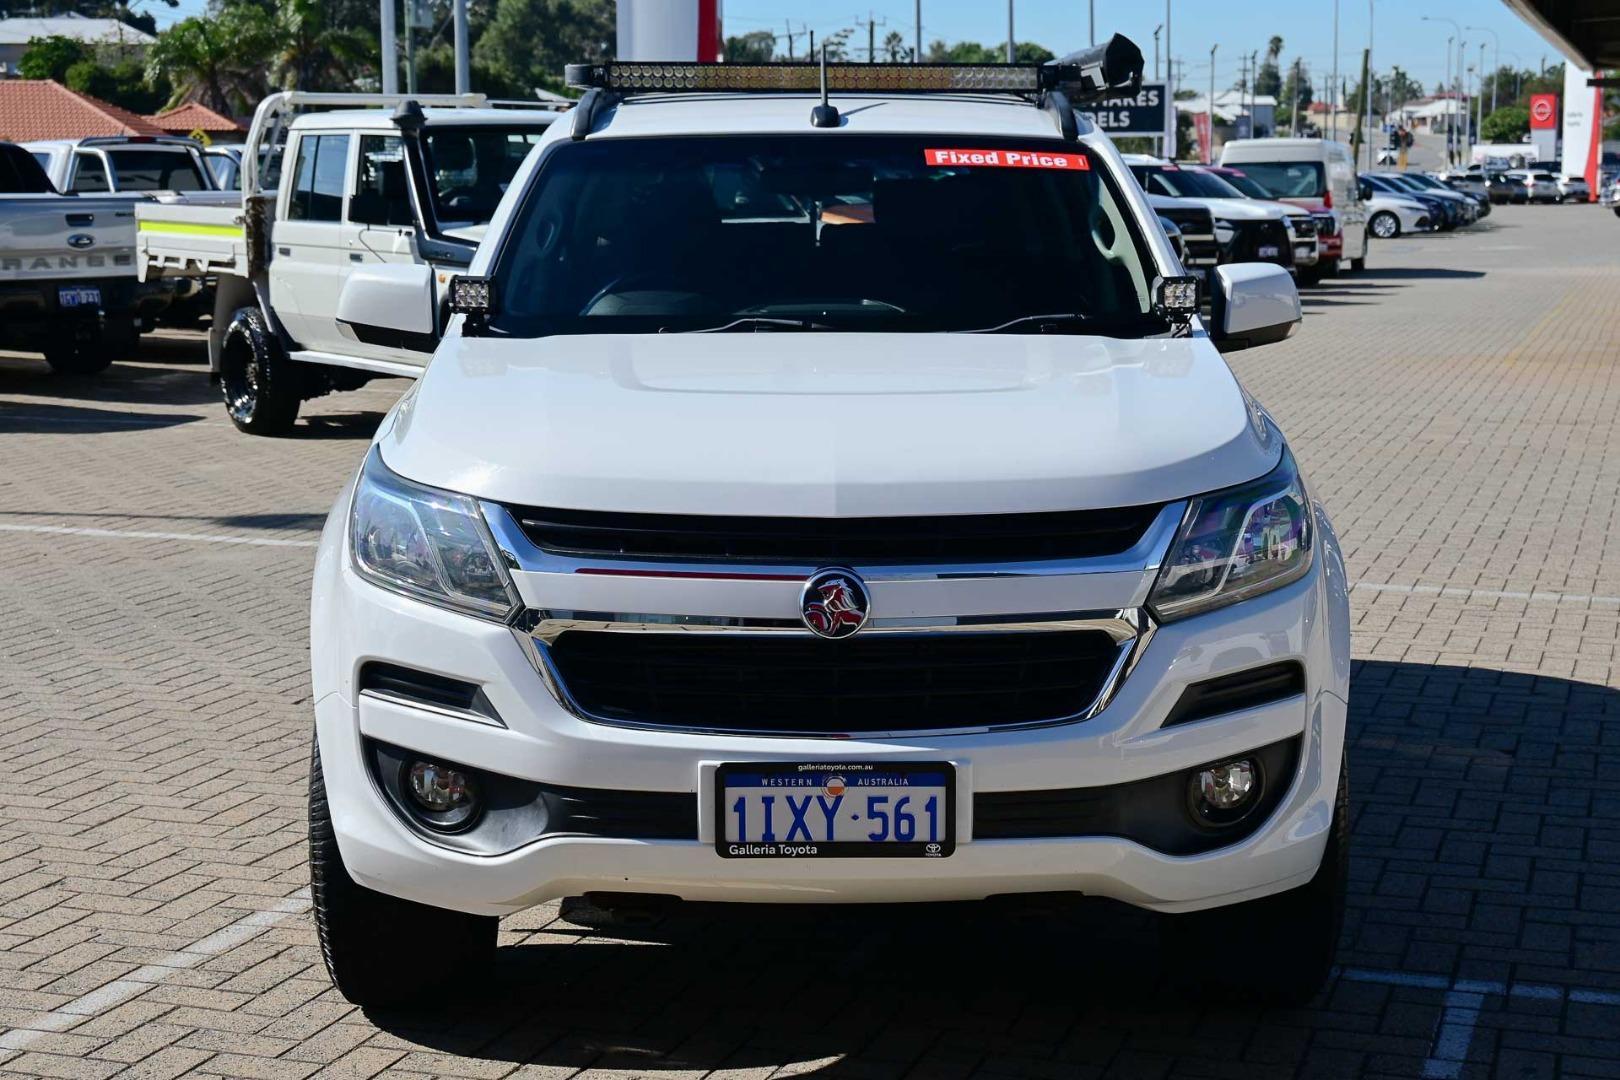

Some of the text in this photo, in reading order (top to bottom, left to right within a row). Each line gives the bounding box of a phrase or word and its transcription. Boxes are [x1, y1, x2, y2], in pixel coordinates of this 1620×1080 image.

[934, 151, 1000, 164] Fixed
[1005, 152, 1068, 167] Price
[1, 253, 131, 271] RANGE
[797, 764, 874, 772] galleriatoyota.com.au
[761, 778, 909, 787] WESTERN AUSTRALIA
[729, 844, 818, 857] Galleria Toyota
